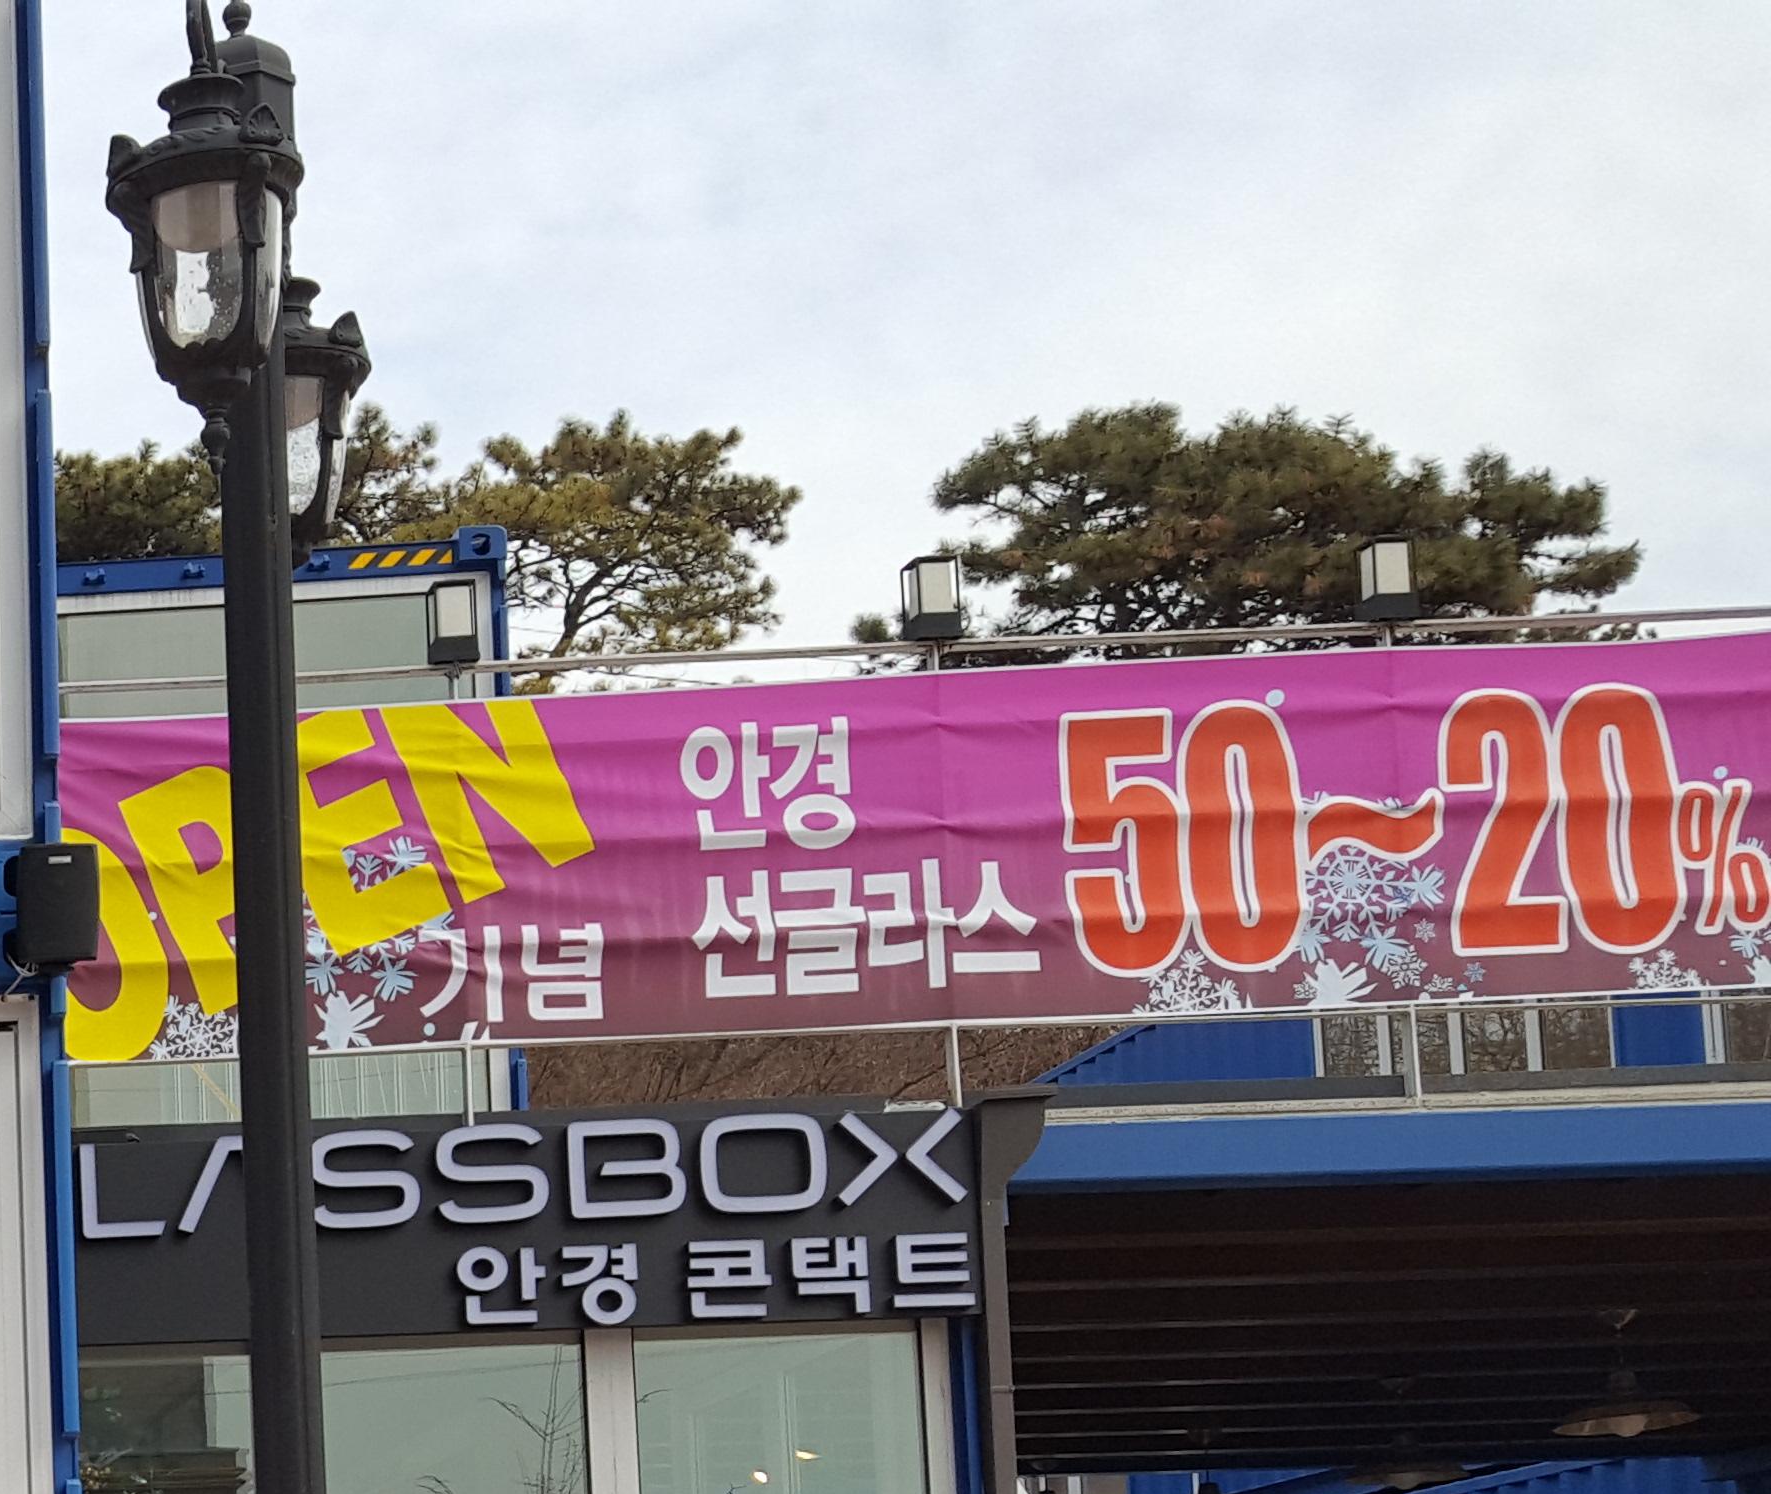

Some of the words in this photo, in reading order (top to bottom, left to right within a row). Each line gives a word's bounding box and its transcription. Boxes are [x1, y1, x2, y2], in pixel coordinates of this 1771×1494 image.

[678, 714, 857, 852] 안경
[59, 698, 594, 1064] PEN
[691, 857, 1042, 1000] 선글라스
[419, 920, 606, 1023] 기념
[79, 1106, 970, 1240] LASSBOX
[456, 1242, 639, 1327] 안경
[686, 1231, 976, 1319] 콘택트
